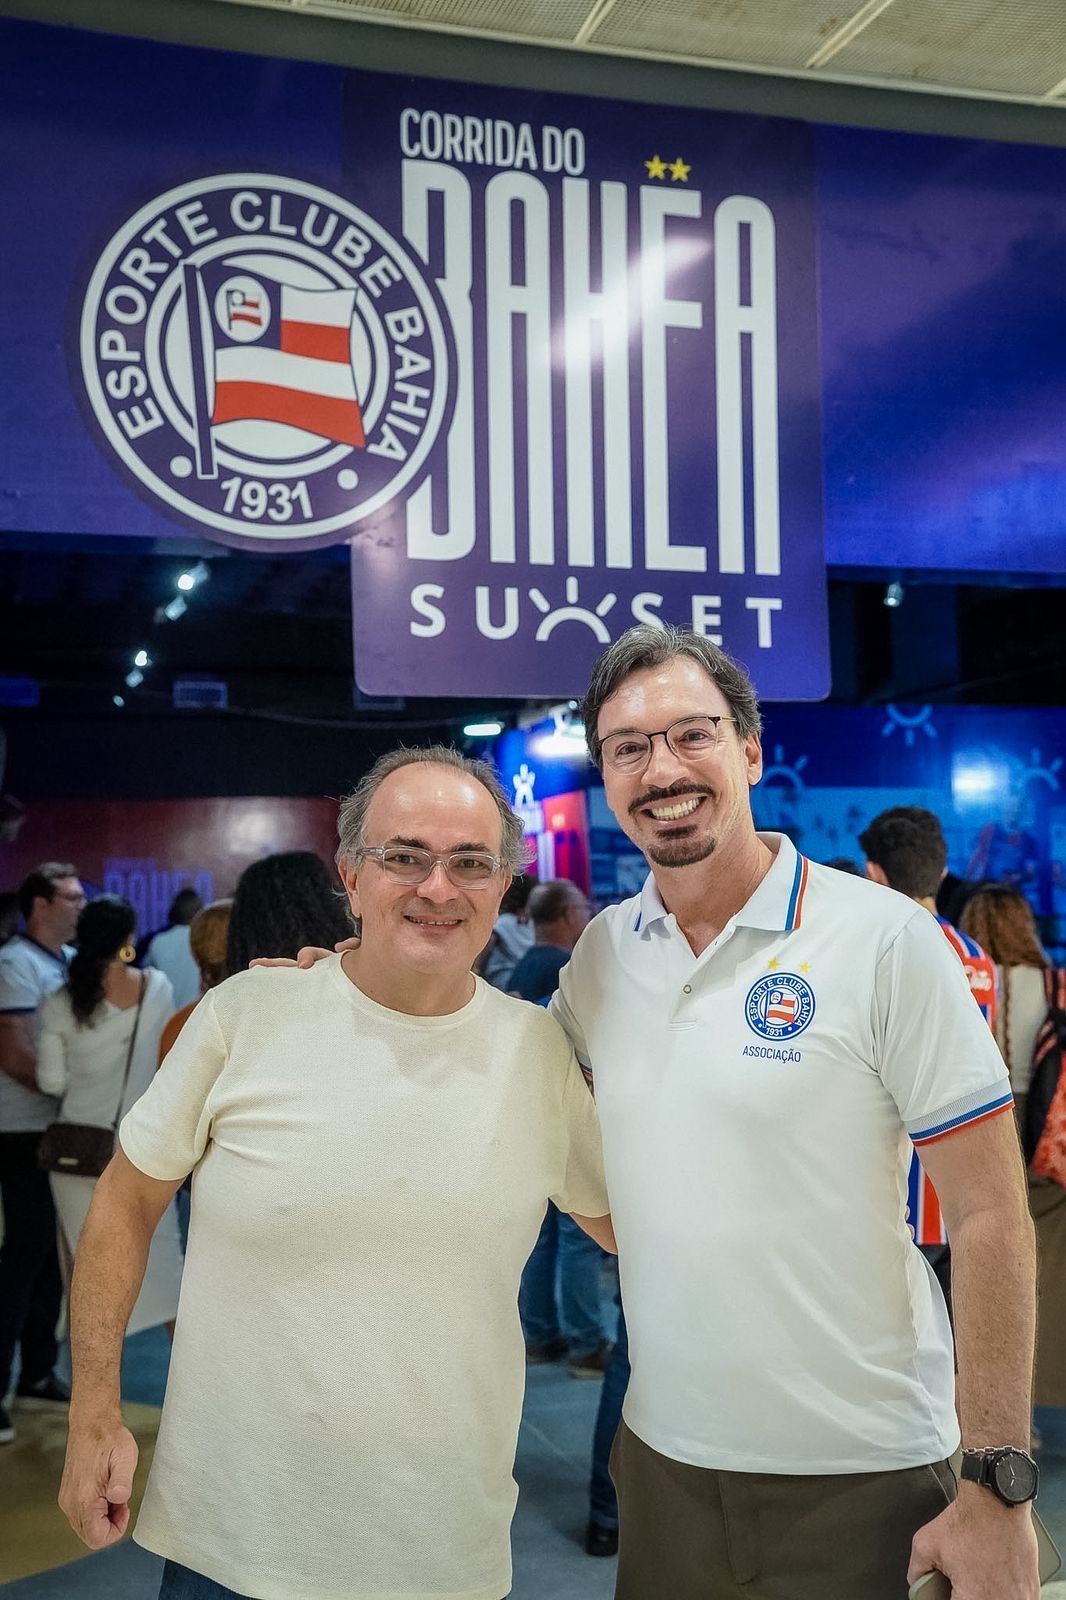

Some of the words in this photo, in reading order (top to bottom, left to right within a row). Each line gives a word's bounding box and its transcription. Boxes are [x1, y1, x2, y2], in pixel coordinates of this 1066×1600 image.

[400, 107, 538, 170] CORRIDA
[543, 125, 585, 176] DO
[100, 200, 218, 440] ESPORTE
[230, 191, 403, 298] CLUBE
[367, 306, 432, 462] BAHIA
[402, 158, 780, 576] BAHEA
[220, 480, 313, 521] 1931
[410, 577, 782, 649] SUSET
[750, 979, 774, 1021] ESPORTE
[776, 977, 807, 996] CLUBE
[795, 996, 810, 1027] BAHIA
[766, 1026, 783, 1037] 1931
[742, 1045, 801, 1064] ASSOCIAÇÃO
